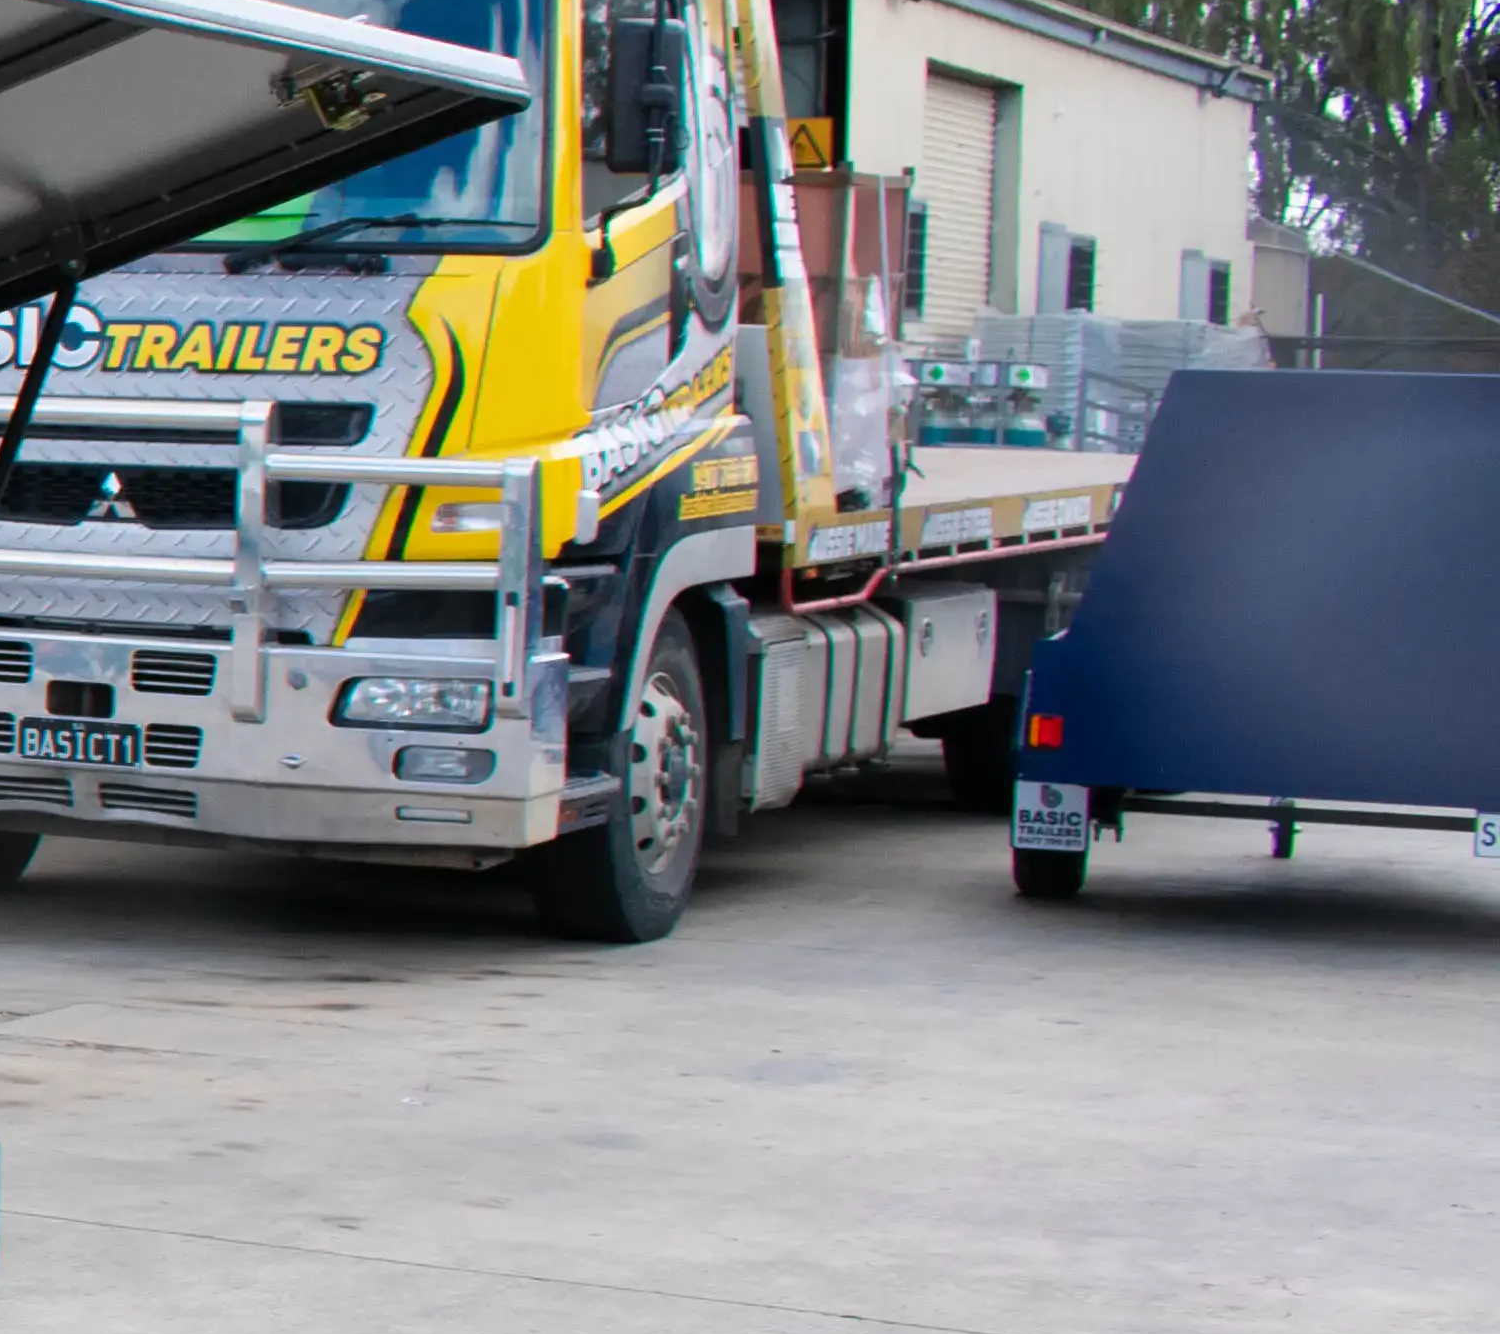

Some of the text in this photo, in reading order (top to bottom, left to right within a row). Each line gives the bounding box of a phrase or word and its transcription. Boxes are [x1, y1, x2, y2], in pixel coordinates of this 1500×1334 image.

[103, 322, 381, 373] TRAILERS
[23, 727, 135, 764] BASICT1
[1018, 809, 1082, 826] BASIC
[1018, 825, 1082, 838] TRAILERS
